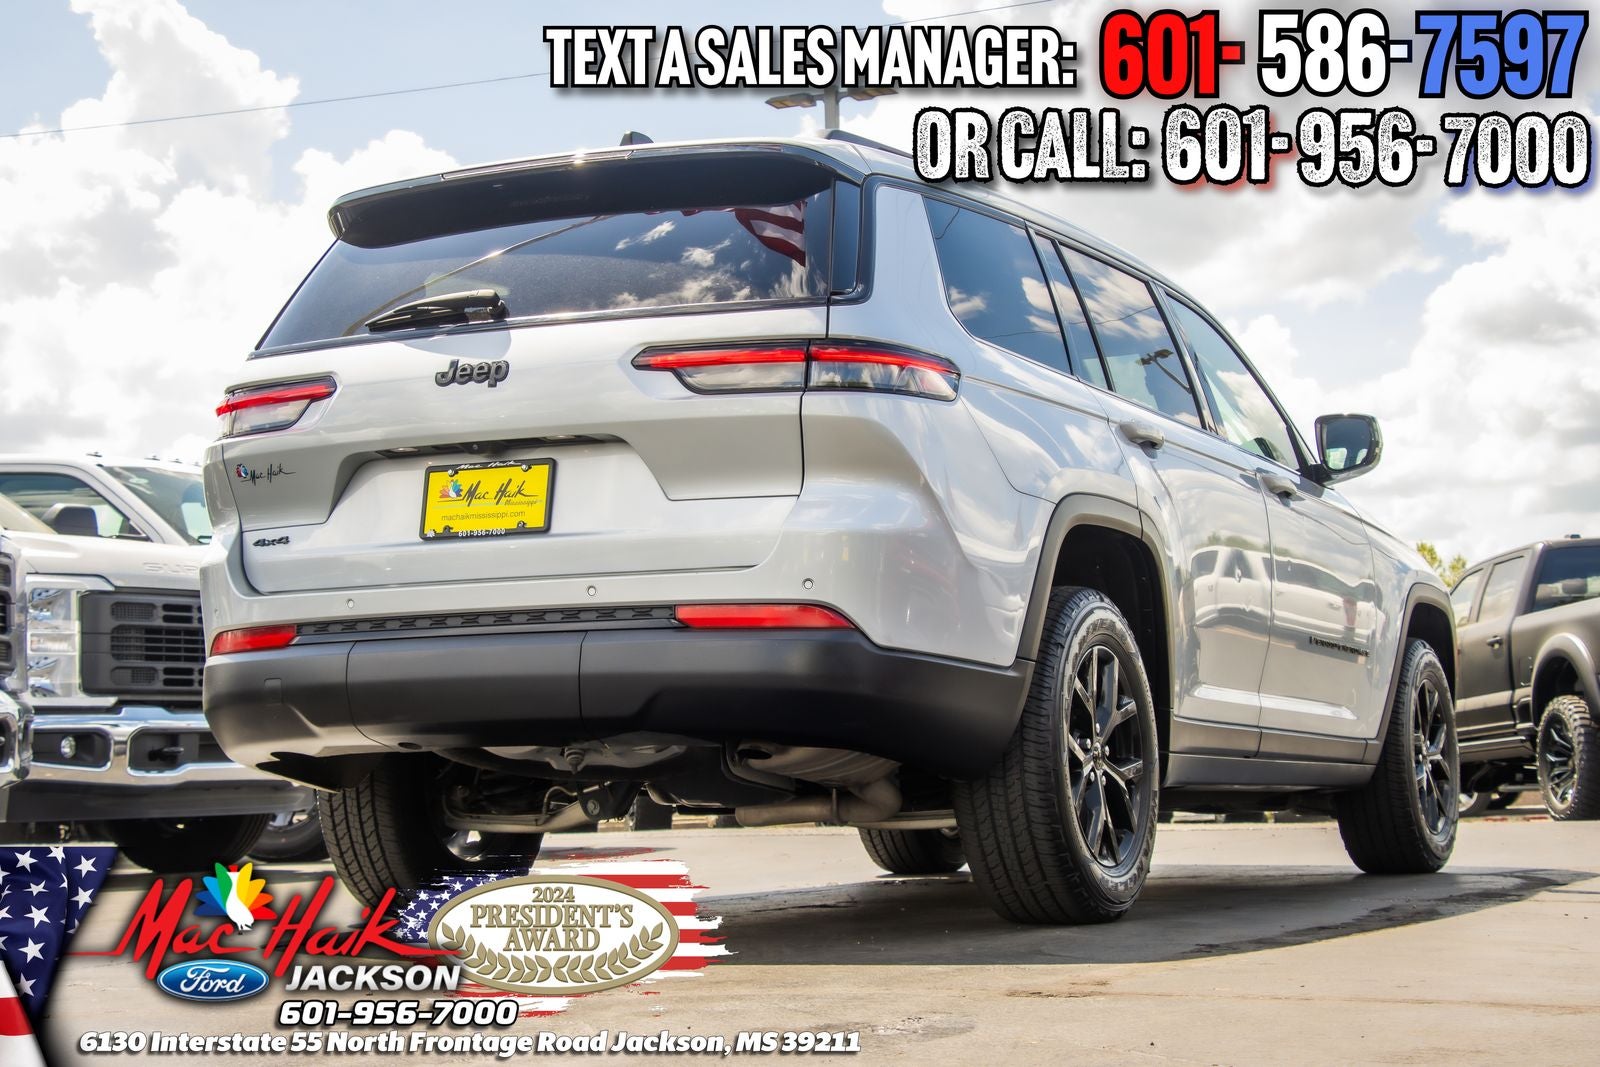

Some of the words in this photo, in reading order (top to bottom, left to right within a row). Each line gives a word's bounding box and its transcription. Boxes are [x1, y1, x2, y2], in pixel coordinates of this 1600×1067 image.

[435, 359, 510, 388] Jeep
[241, 470, 266, 486] Mac
[267, 463, 296, 483] Haik
[494, 478, 539, 505] Haik
[441, 510, 526, 521] machaikmississippi.com
[458, 528, 506, 537] 601-956-7000
